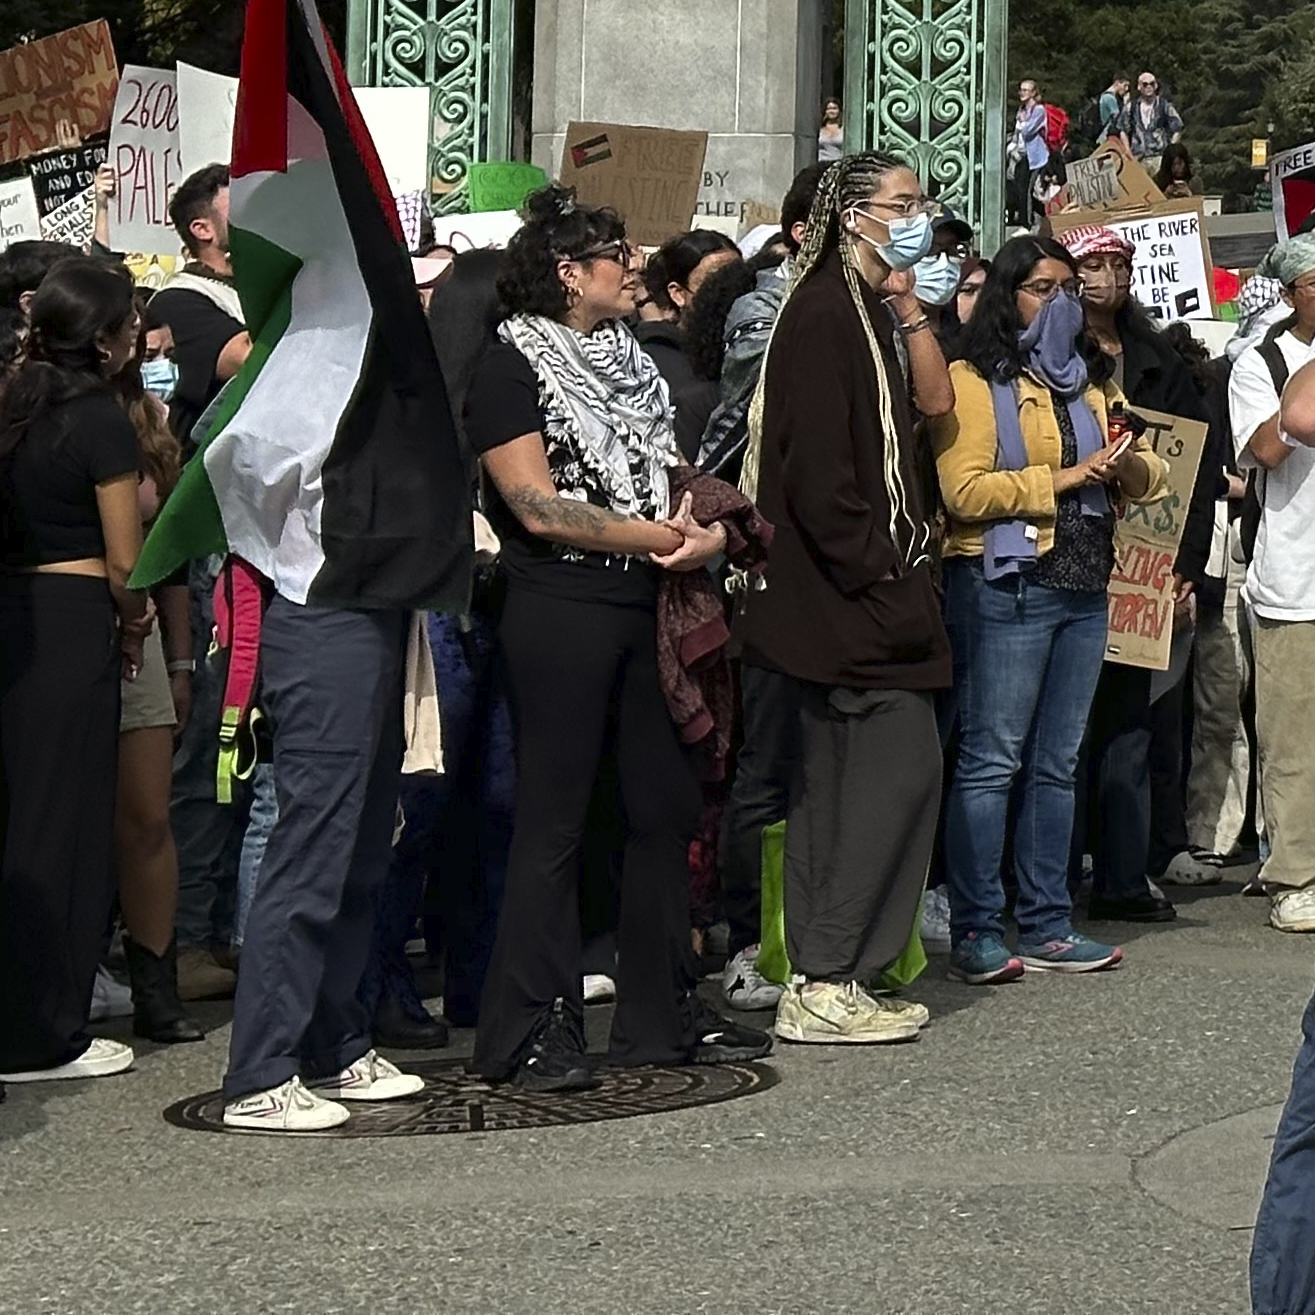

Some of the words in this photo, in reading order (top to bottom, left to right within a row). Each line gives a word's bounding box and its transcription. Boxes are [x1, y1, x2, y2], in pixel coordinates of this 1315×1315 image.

[31, 153, 77, 176] MONEY
[84, 147, 106, 166] FOR
[48, 174, 72, 192] AND
[117, 143, 183, 227] PALE
[704, 171, 729, 186] BY
[46, 201, 80, 228] LONG
[1119, 224, 1151, 243] THE
[1157, 218, 1199, 238] RIVER
[1149, 243, 1175, 258] SEA
[1152, 288, 1169, 304] BE
